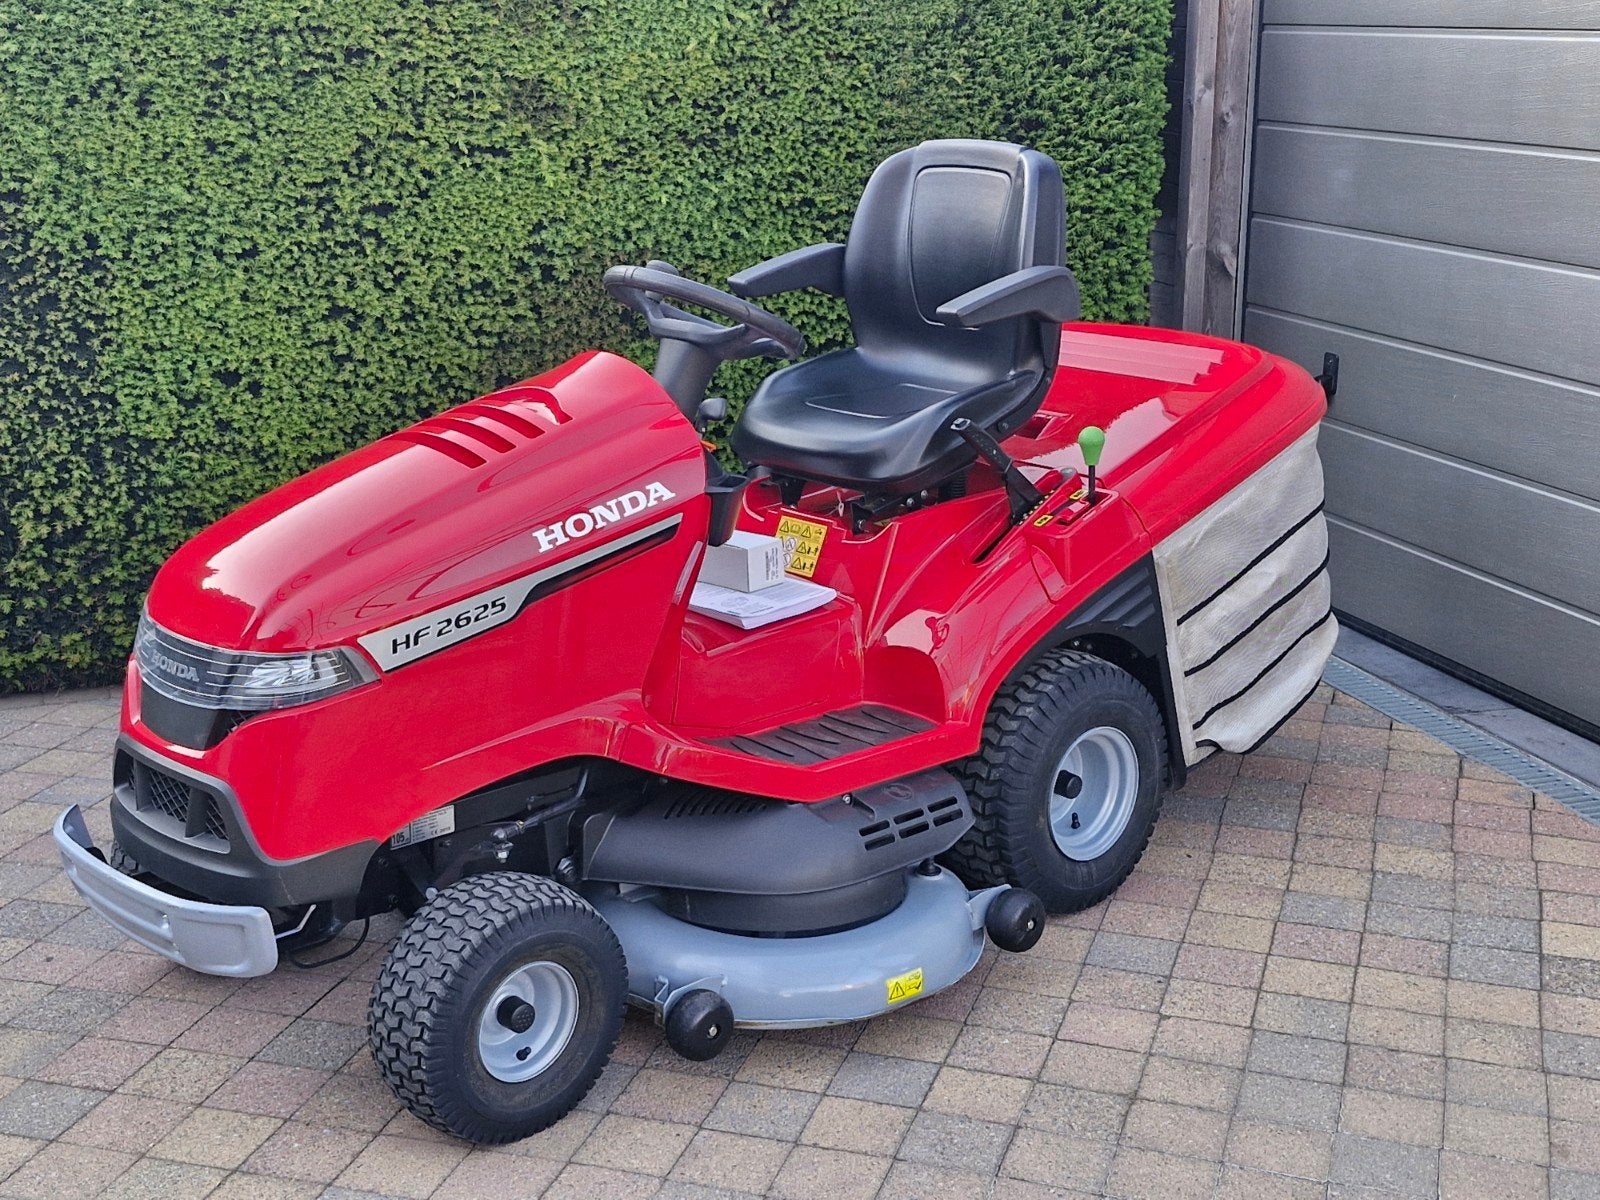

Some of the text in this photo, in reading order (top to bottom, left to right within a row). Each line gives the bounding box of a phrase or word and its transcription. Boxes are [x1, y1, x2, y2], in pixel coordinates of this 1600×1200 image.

[532, 481, 676, 553] HONDA
[392, 596, 507, 654] HF 2625
[151, 649, 200, 682] HONDA
